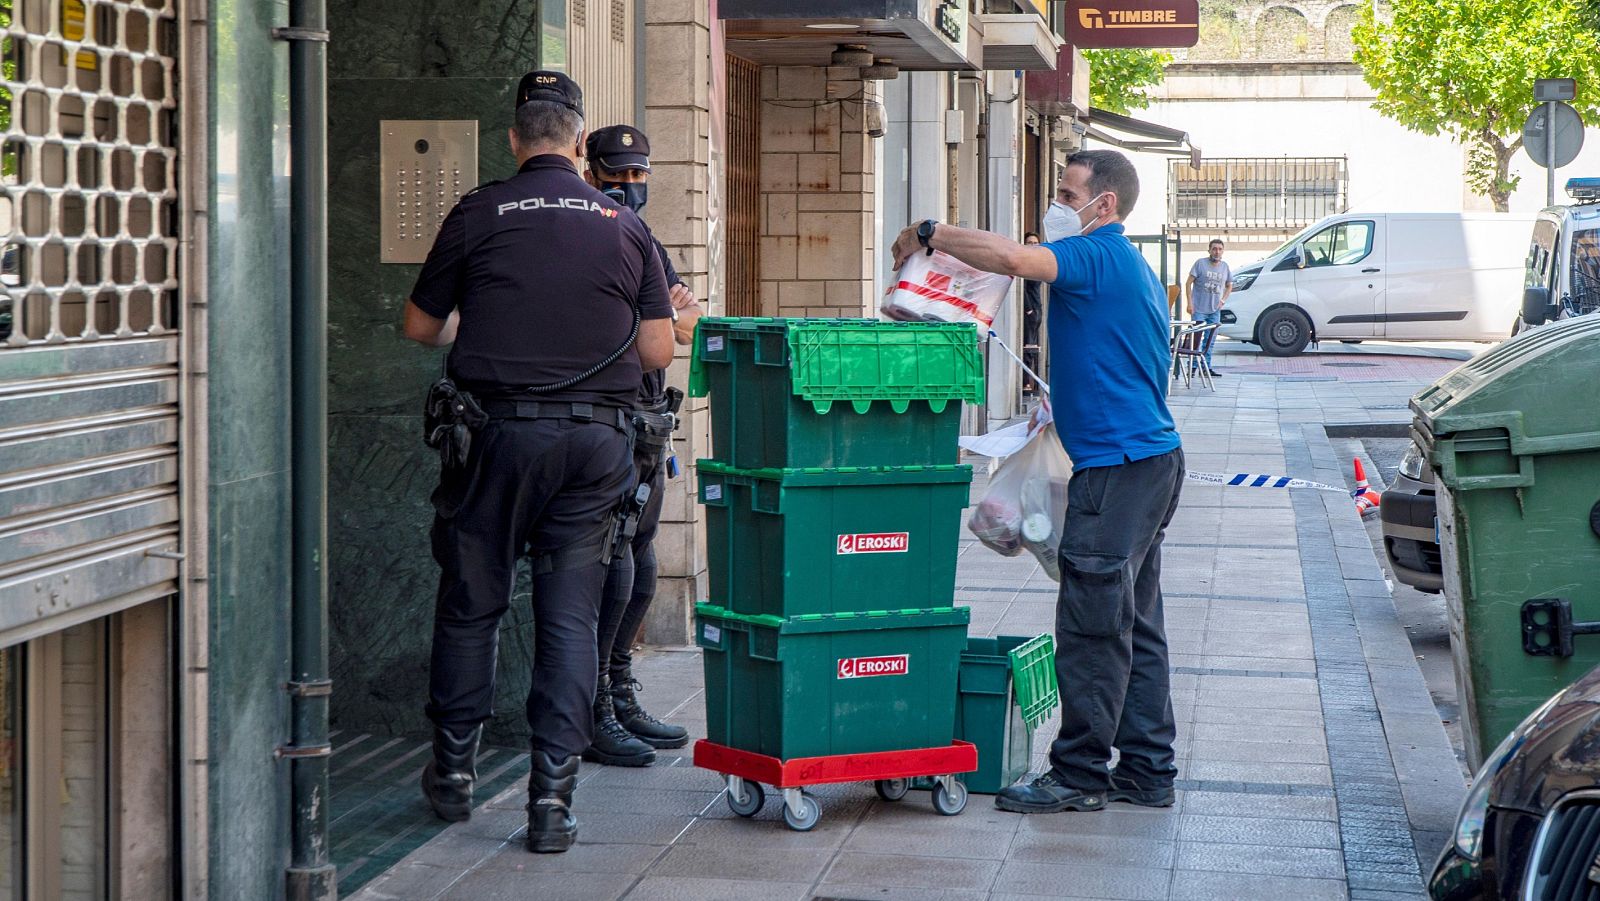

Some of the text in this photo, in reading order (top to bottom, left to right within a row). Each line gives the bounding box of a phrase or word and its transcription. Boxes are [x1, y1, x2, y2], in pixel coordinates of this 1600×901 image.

[1108, 10, 1176, 23] TIMBRE
[536, 76, 557, 84] CNP
[498, 197, 604, 216] POLICIA
[858, 536, 904, 549] EROSKI
[858, 659, 904, 673] EROSKI
